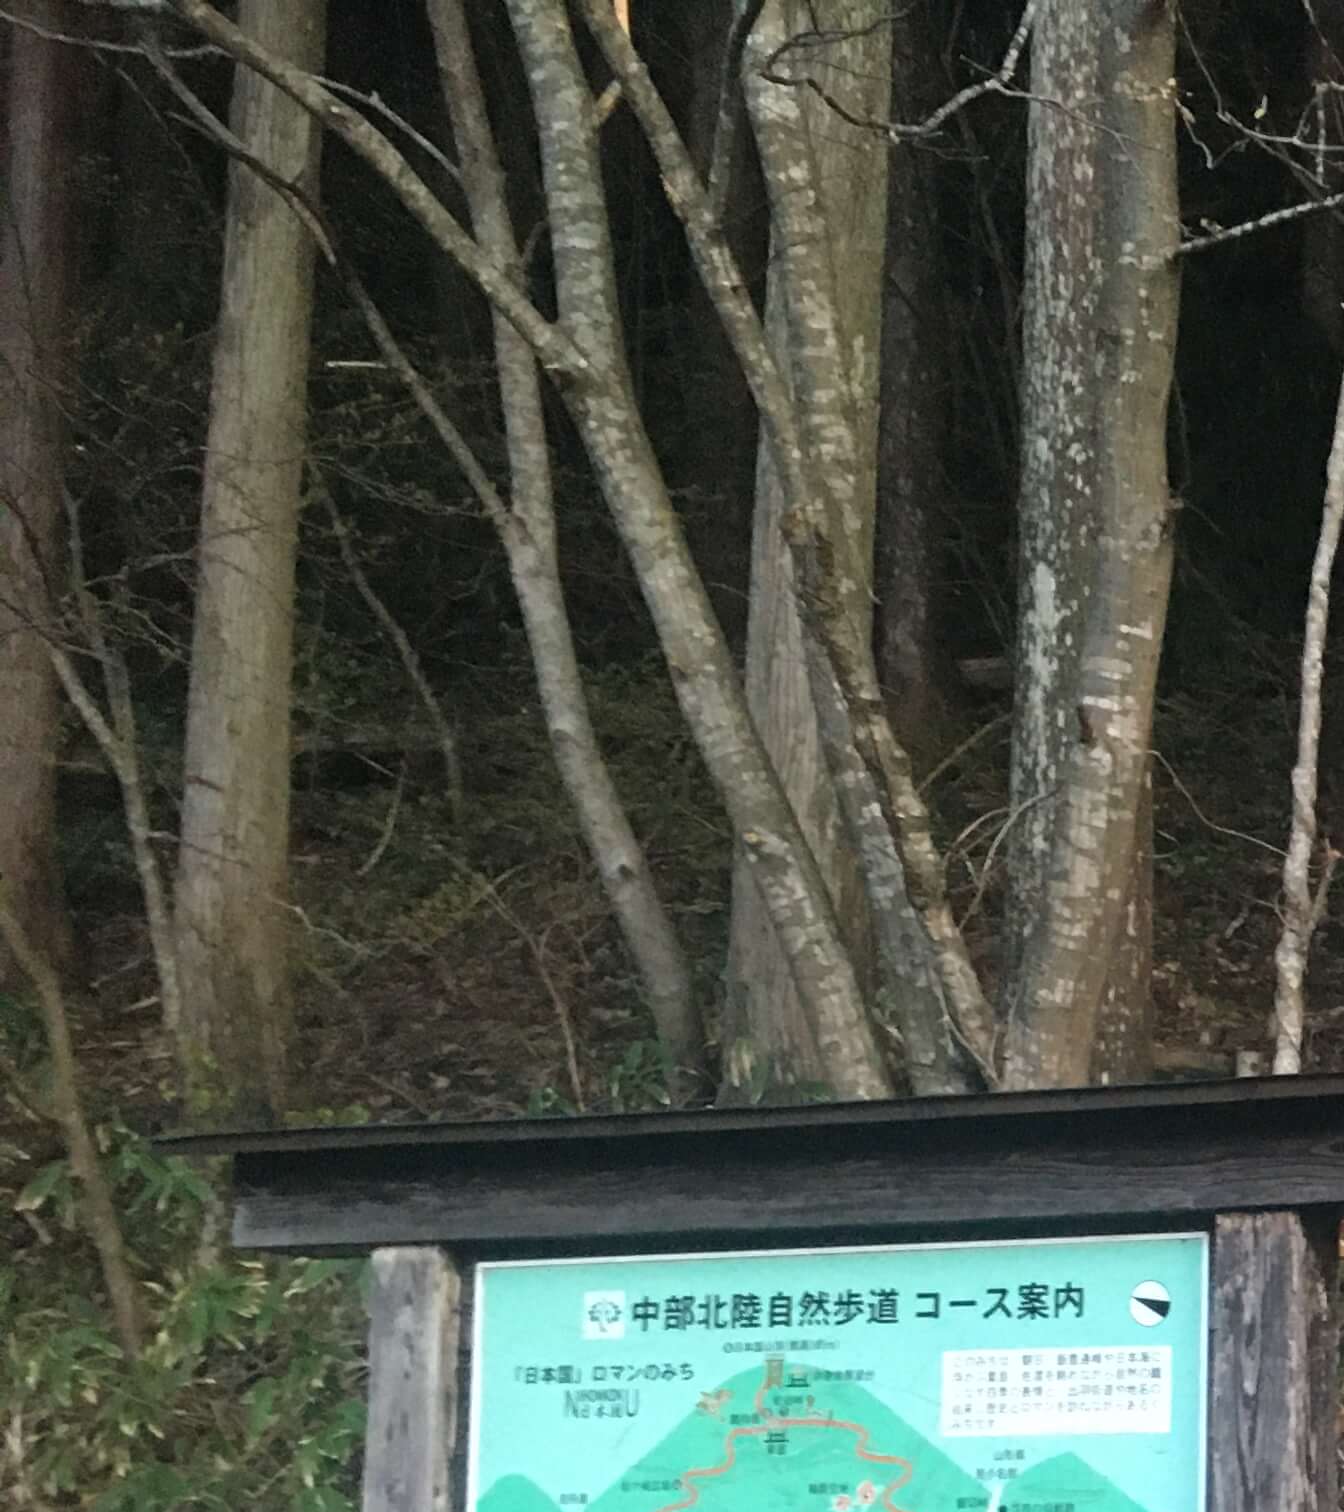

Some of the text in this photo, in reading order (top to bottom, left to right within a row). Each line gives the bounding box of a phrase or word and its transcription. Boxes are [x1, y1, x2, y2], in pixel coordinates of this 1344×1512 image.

[632, 1282, 1085, 1331] 中部北陸自然歩道 コース案内
[592, 1362, 695, 1383] ロマンのみち
